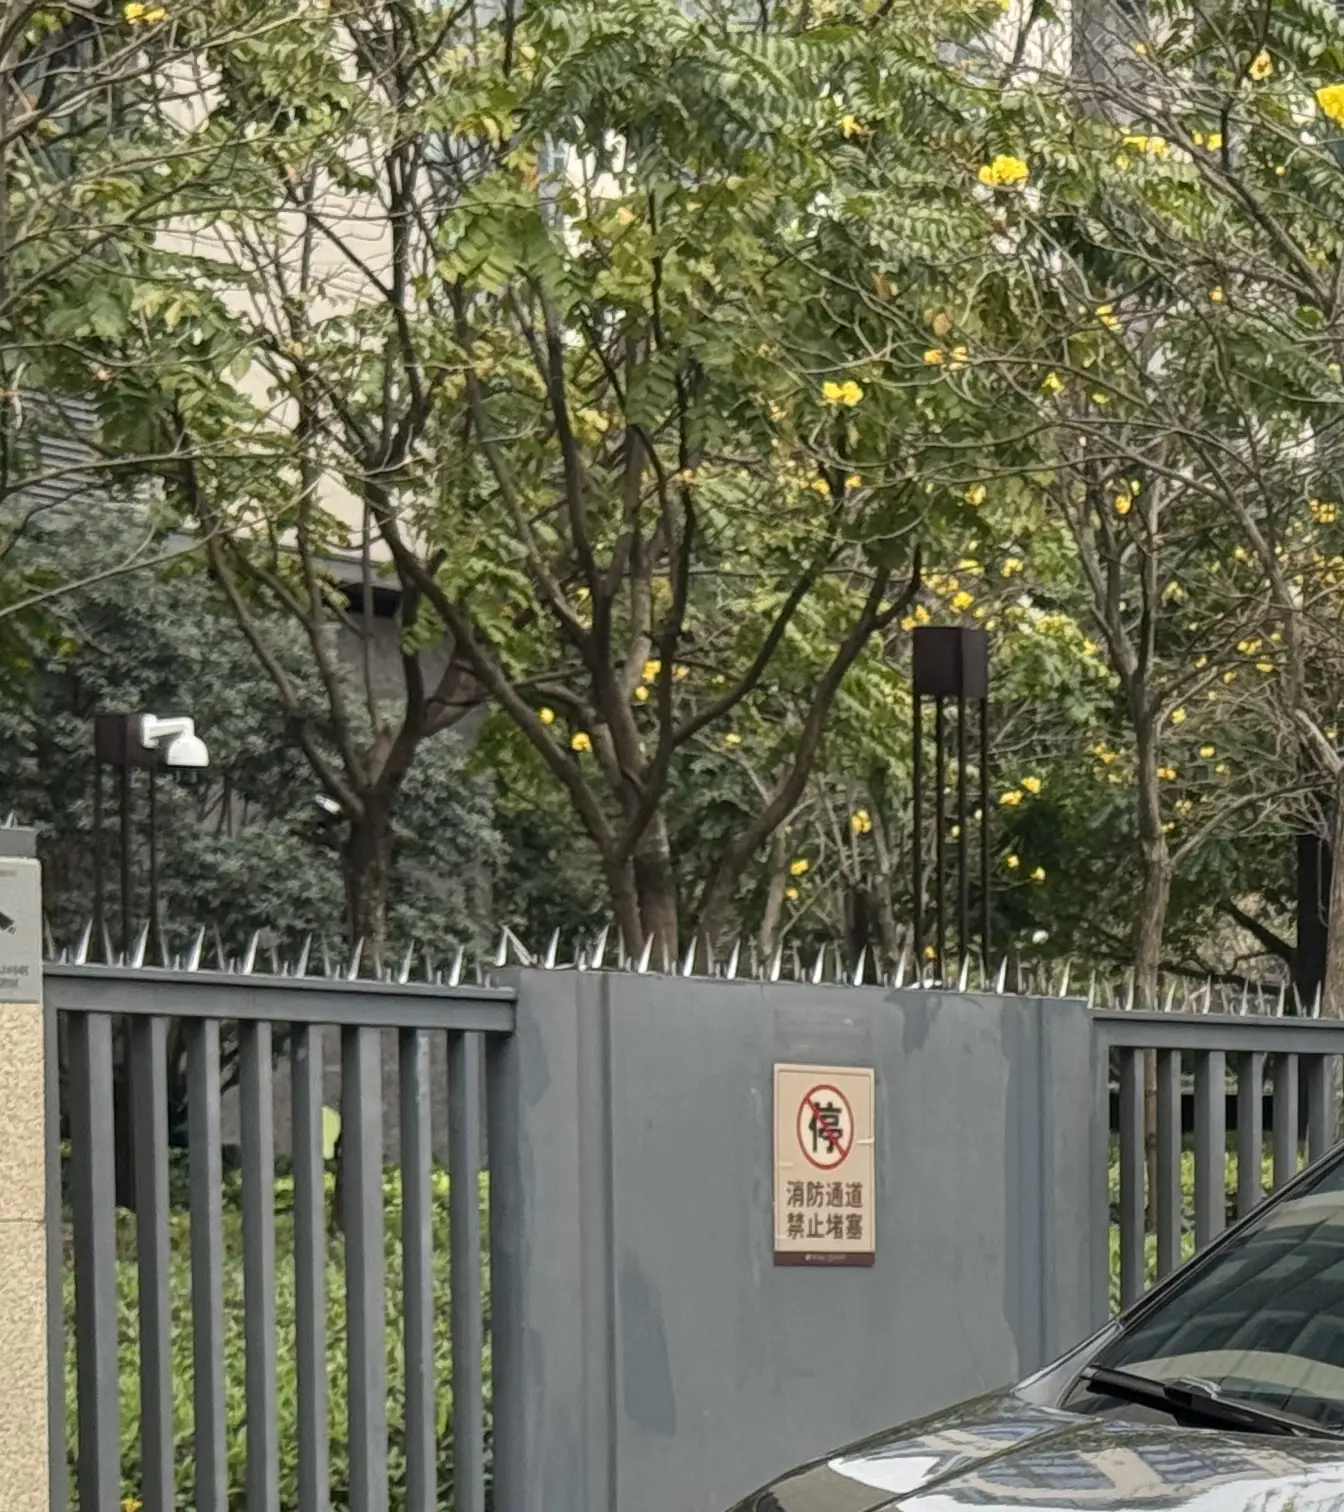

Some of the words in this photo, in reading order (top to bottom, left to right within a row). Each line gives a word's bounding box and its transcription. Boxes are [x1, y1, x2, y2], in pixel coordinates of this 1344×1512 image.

[808, 1101, 843, 1154] 停
[786, 1180, 863, 1208] 消防通道
[786, 1211, 863, 1240] 禁止堵塞
